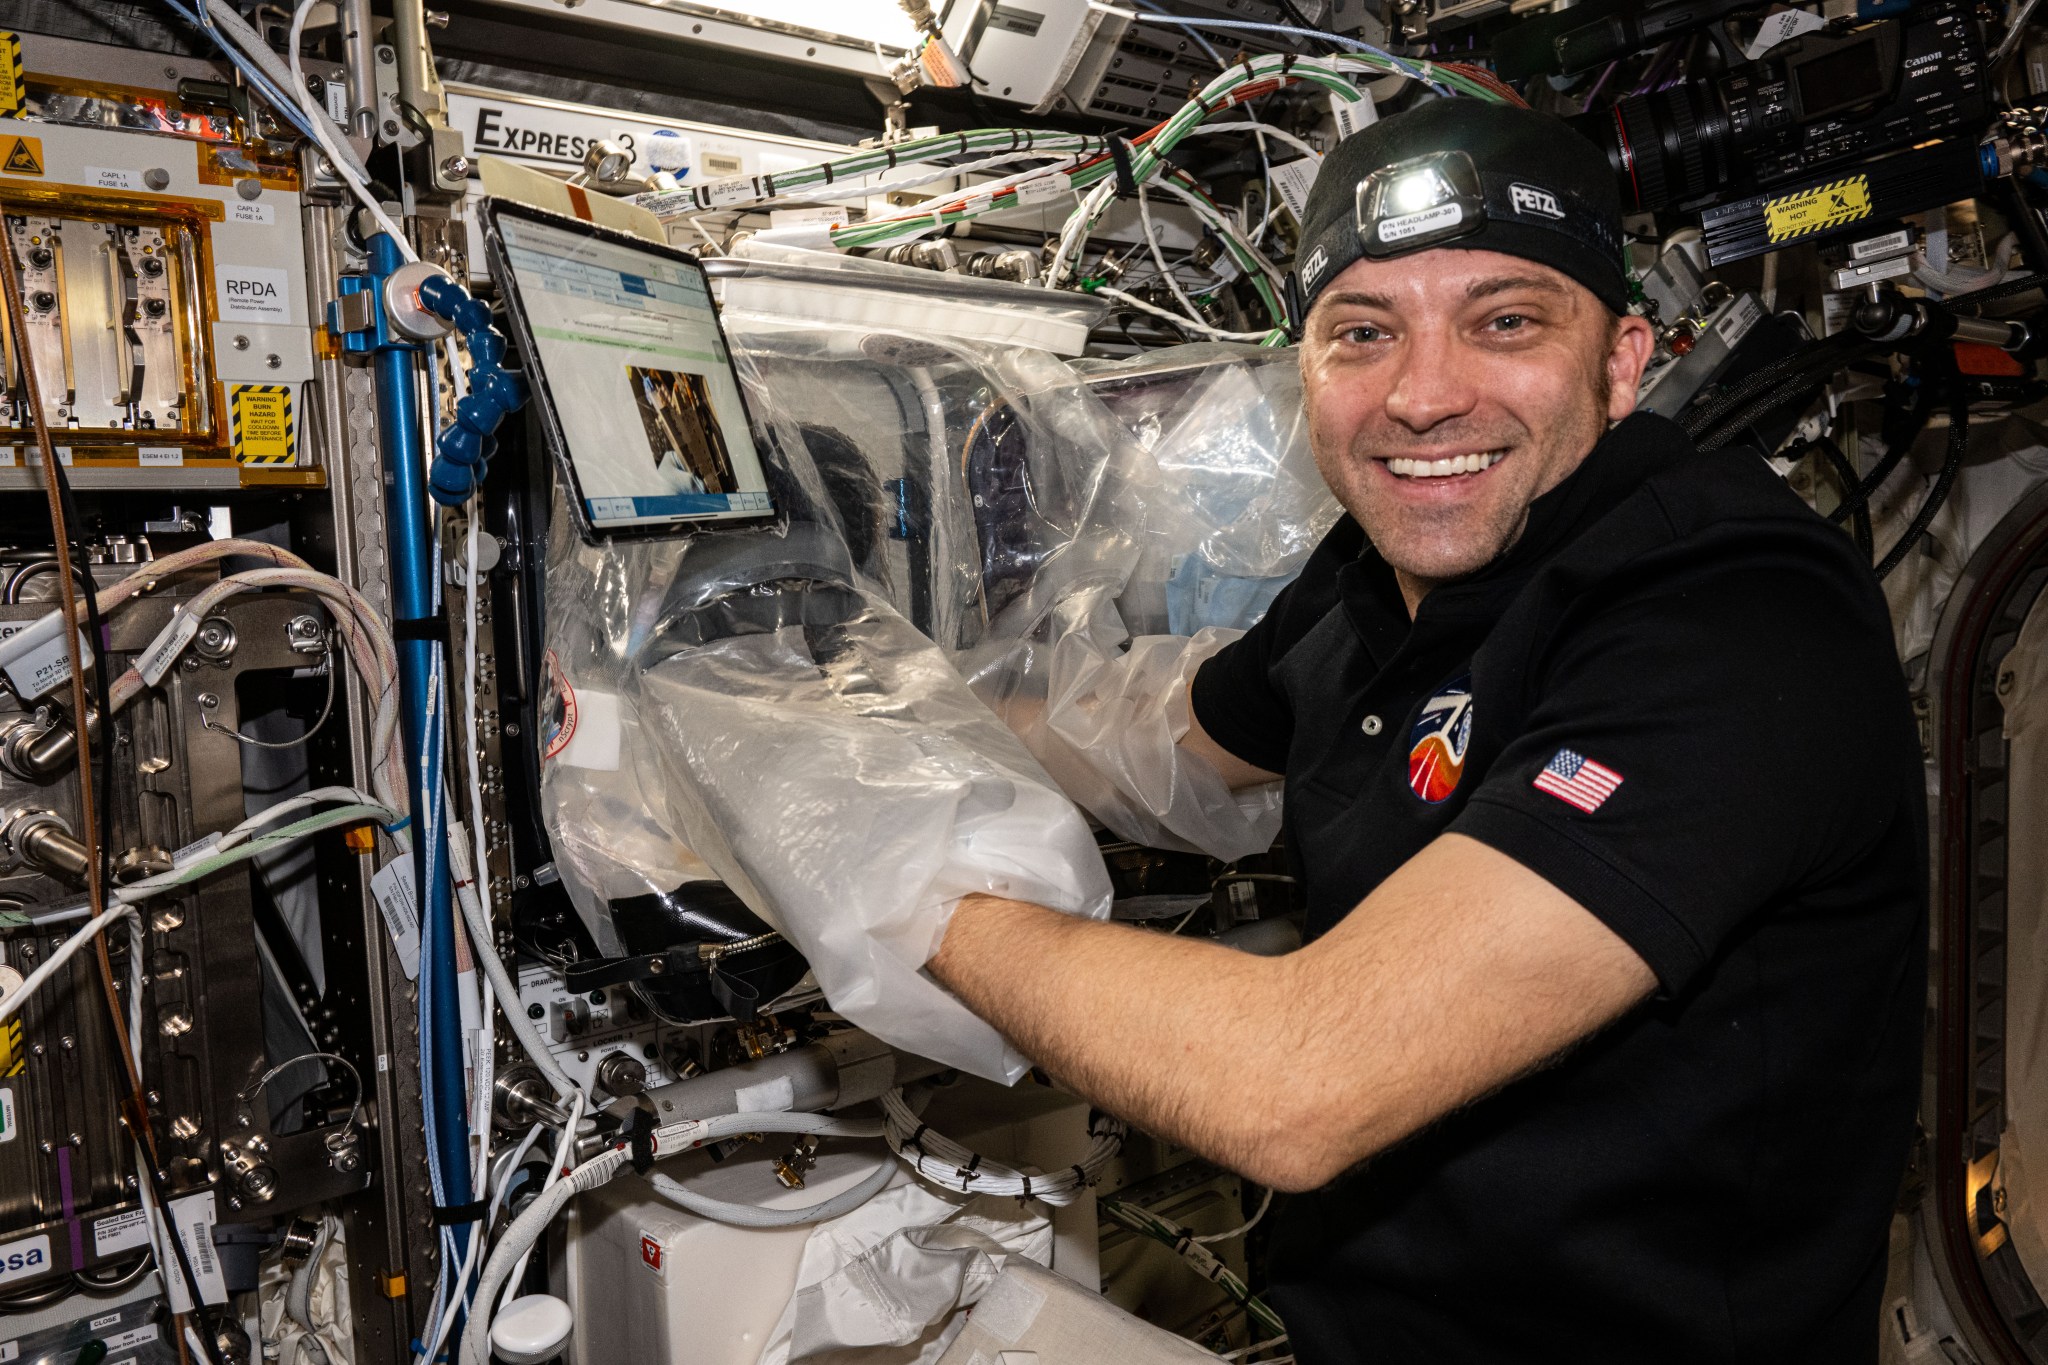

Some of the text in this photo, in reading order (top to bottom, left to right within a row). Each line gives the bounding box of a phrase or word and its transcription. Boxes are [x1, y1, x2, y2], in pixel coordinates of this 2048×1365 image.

[1905, 51, 1943, 68] Canon
[618, 133, 637, 165] 3
[101, 171, 121, 180] CAPL
[98, 179, 118, 187] FUSE
[236, 205, 254, 213] CAPL
[1512, 185, 1565, 219] PETZL
[1776, 197, 1818, 214] WARNING
[235, 212, 263, 222] FUSE 1A
[1382, 206, 1456, 231] P/N HEADLAMP-301
[1789, 210, 1808, 222] HOT
[1384, 226, 1416, 239] S/N 1051
[1777, 218, 1817, 233] DO NOT TOUCH
[1302, 249, 1329, 296] PETZL
[226, 280, 277, 297] RPDA
[40, 673, 55, 683] Metal
[54, 668, 62, 676] 3D
[34, 674, 63, 693] Sealed Box
[558, 713, 574, 743] nScrypt
[401, 875, 411, 892] Sealed
[531, 976, 558, 988] DRAWER
[593, 1033, 623, 1047] LOCKER
[600, 1045, 619, 1053] POWER
[96, 1213, 134, 1227] Sealed Box
[93, 1315, 117, 1327] CLOSE
[122, 1339, 136, 1347] from
